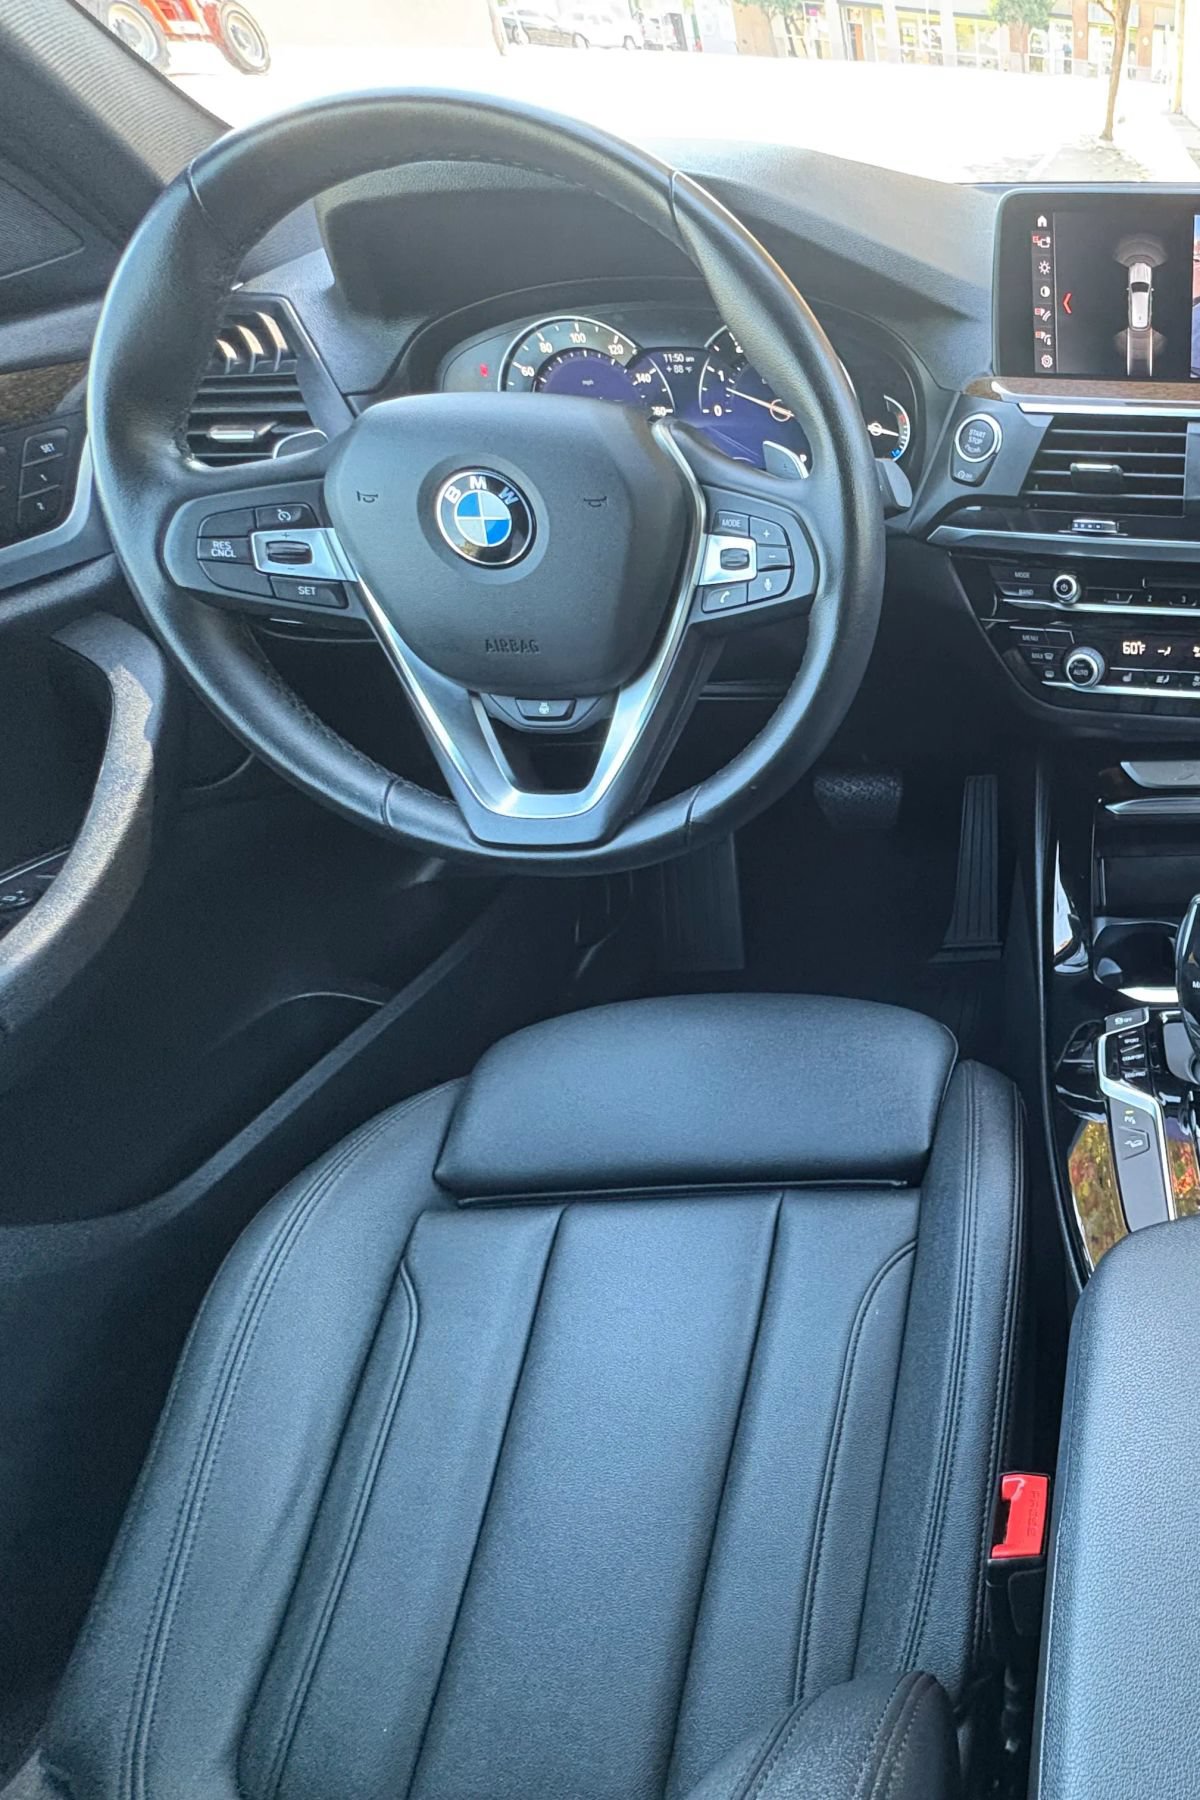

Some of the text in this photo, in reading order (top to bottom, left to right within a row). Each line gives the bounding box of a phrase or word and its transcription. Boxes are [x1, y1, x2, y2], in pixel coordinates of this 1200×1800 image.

[570, 333, 586, 344] 100
[539, 342, 553, 353] 80
[608, 344, 624, 355] 120
[663, 353, 684, 363] 11:50
[521, 366, 534, 377] 60
[673, 365, 684, 374] 88
[636, 372, 651, 384] 140
[717, 370, 725, 382] 1
[713, 405, 722, 417] 0
[968, 429, 986, 439] START
[967, 436, 983, 445] STOP
[40, 443, 55, 453] SET
[444, 475, 519, 505] BMW
[721, 518, 741, 528] MODE
[212, 540, 232, 550] RES
[211, 548, 237, 558] CNCL
[1014, 571, 1030, 579] MODE
[297, 585, 317, 595] SET
[1018, 588, 1034, 596] BAND
[1021, 634, 1039, 642] MENU
[485, 638, 540, 654] AIRBAG
[1072, 669, 1089, 677] AUTO
